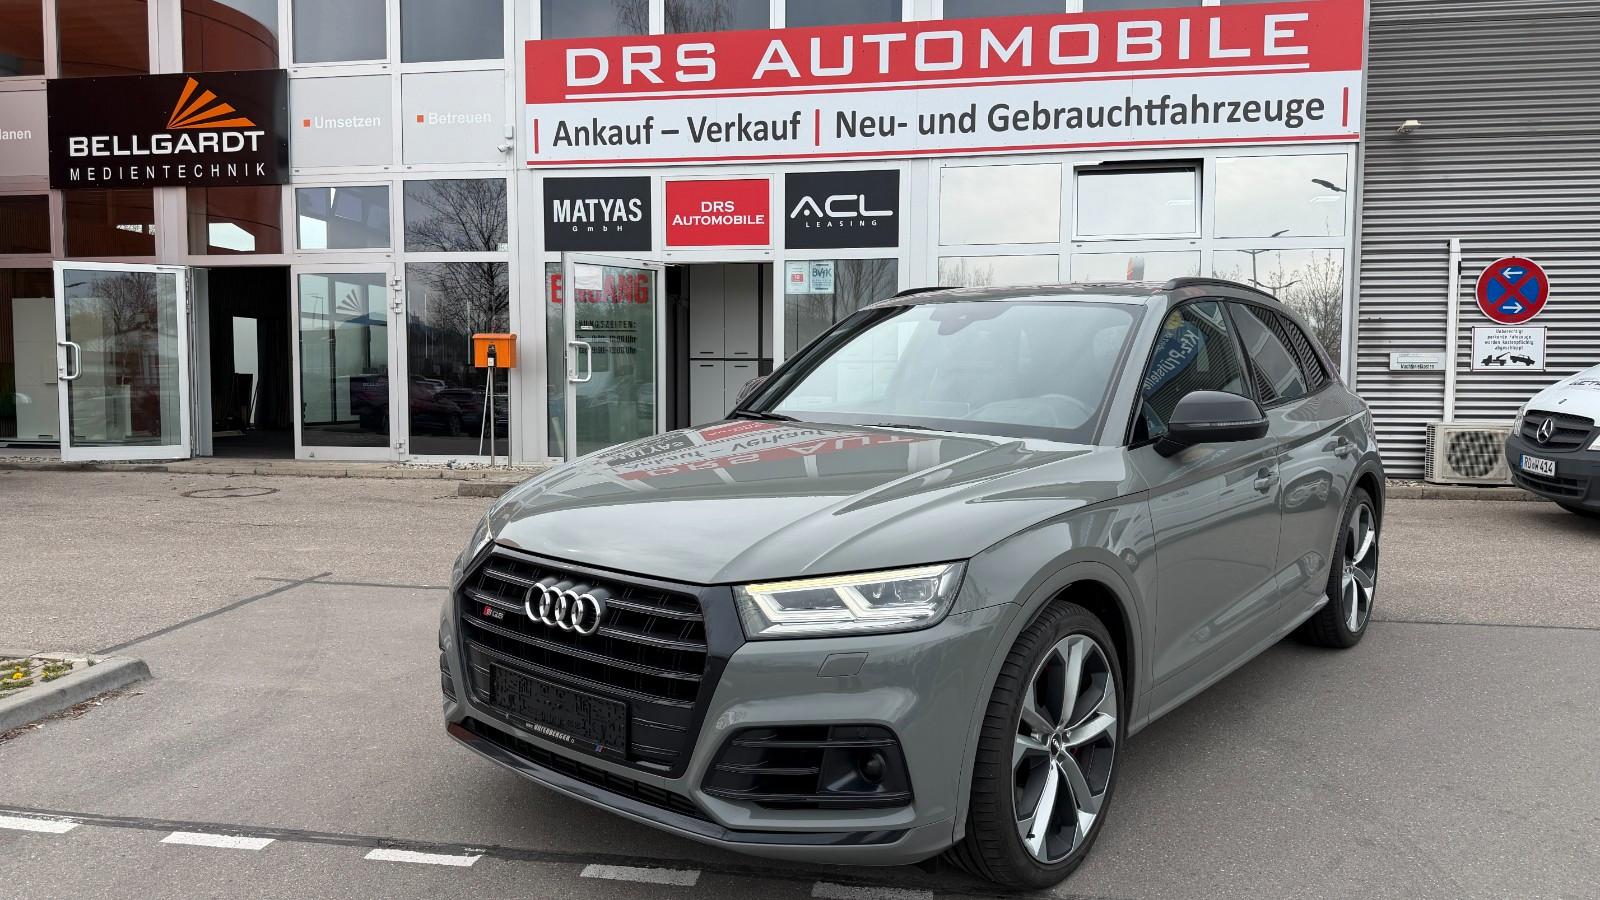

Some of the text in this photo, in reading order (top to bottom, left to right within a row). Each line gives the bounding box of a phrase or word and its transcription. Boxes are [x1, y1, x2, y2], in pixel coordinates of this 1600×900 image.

[565, 12, 1309, 87] DRS AUTOMOBILE
[314, 113, 381, 130] Umsetzen
[428, 110, 492, 126] Betreuen
[552, 115, 654, 147] Ankauf
[687, 110, 802, 143] Verkauf
[836, 109, 908, 139] Neu-
[918, 104, 976, 135] und
[987, 93, 1325, 132] Gebrauchtfahrzeuge
[68, 130, 265, 157] BELLGARDT
[69, 163, 266, 182] MEDIENTECHNIK
[553, 197, 643, 224] MATYAS
[700, 200, 735, 213] DRS
[790, 193, 894, 219] ACL
[672, 214, 765, 226] AUTOMOBILE
[805, 220, 879, 228] LEASING
